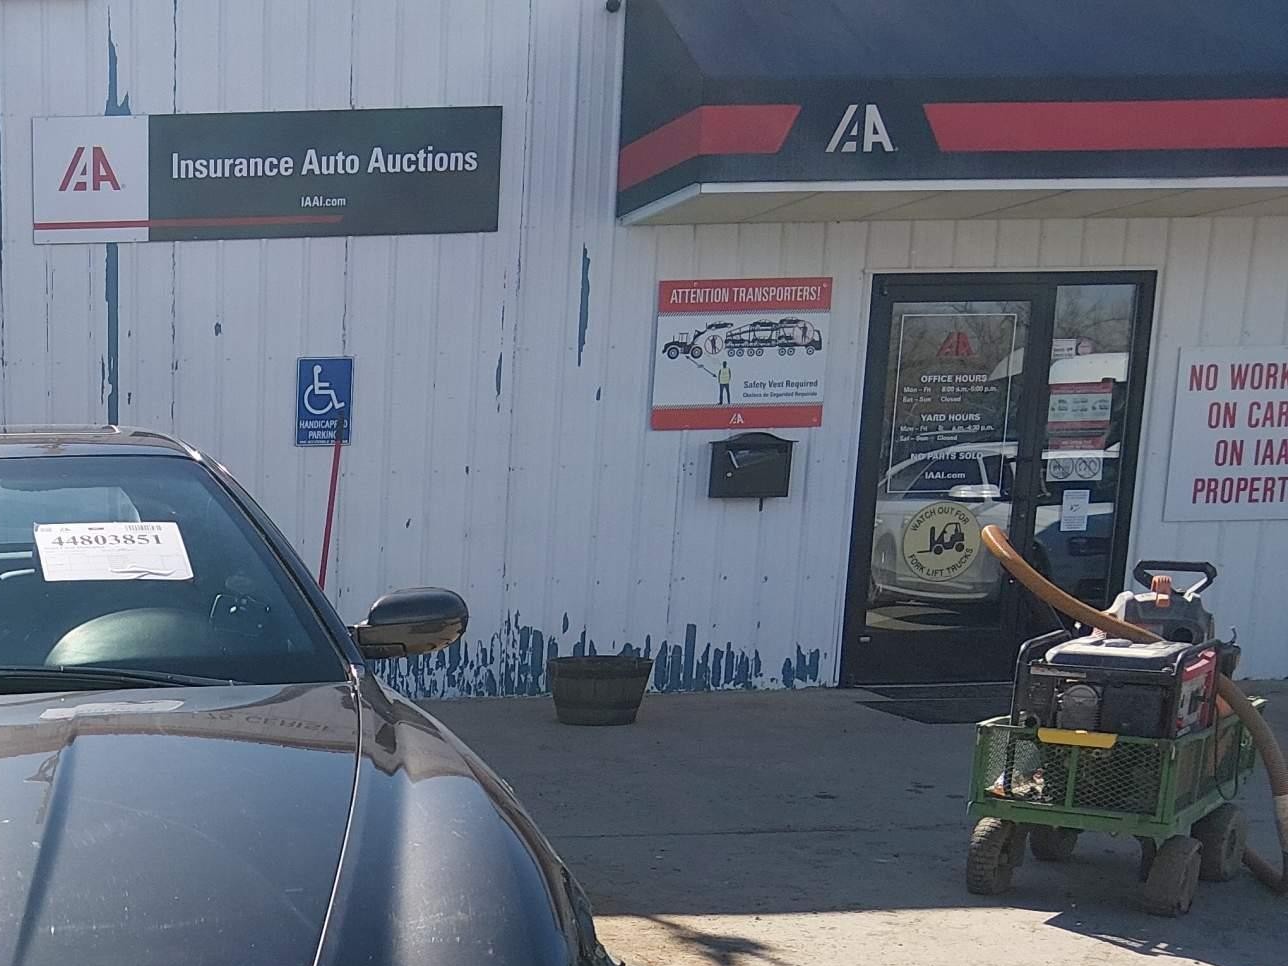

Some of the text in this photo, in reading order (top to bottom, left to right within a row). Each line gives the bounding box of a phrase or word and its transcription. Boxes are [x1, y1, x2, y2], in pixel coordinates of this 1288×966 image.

[171, 146, 478, 179] Insurance Auto Auctions
[300, 196, 346, 208] IAAI.com
[670, 286, 821, 304] ATTENTION TRANSPORTERS!
[920, 374, 988, 383] OFFICE HOURS
[1189, 362, 1288, 391] NO WORK
[743, 379, 818, 390] Safety Vest Required
[921, 413, 981, 422] YARD HOURS
[1208, 402, 1237, 429] ON
[299, 419, 348, 429] HANDICAPPD
[911, 451, 984, 460] NO PARTS SOLD
[1215, 439, 1244, 466] ON
[925, 471, 966, 479] IAAI.com
[1192, 476, 1288, 504] PROPERT
[910, 506, 970, 531] WATCH OUT FOR
[51, 534, 162, 547] 44803851
[908, 547, 974, 577] FORK LIFT TRUCKS
